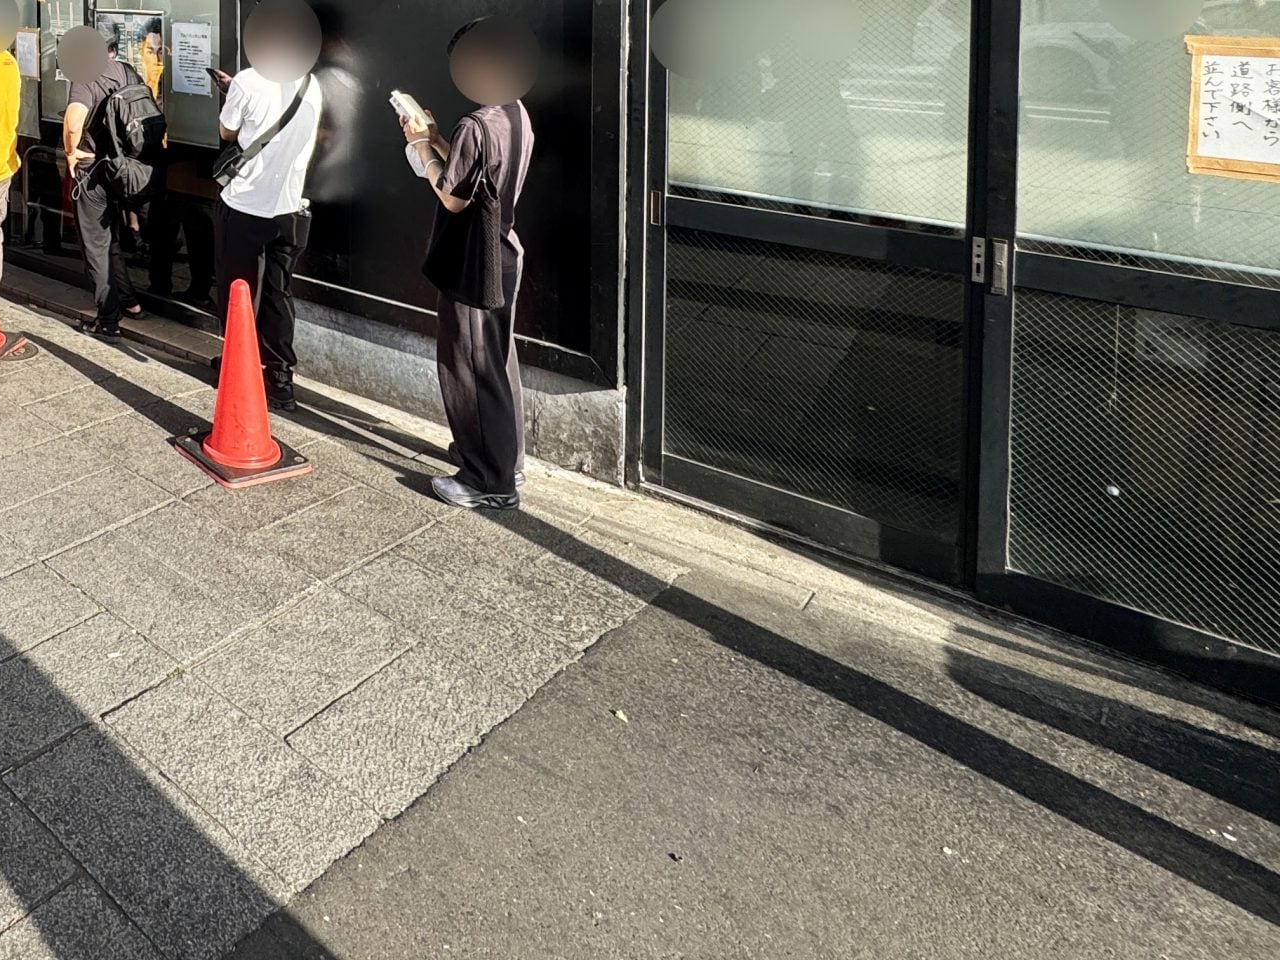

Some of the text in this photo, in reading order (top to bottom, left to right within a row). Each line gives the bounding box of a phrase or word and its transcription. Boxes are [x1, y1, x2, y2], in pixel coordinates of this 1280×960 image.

[1202, 61, 1224, 139] 並んで下さい
[1230, 61, 1254, 131] 道路側へ
